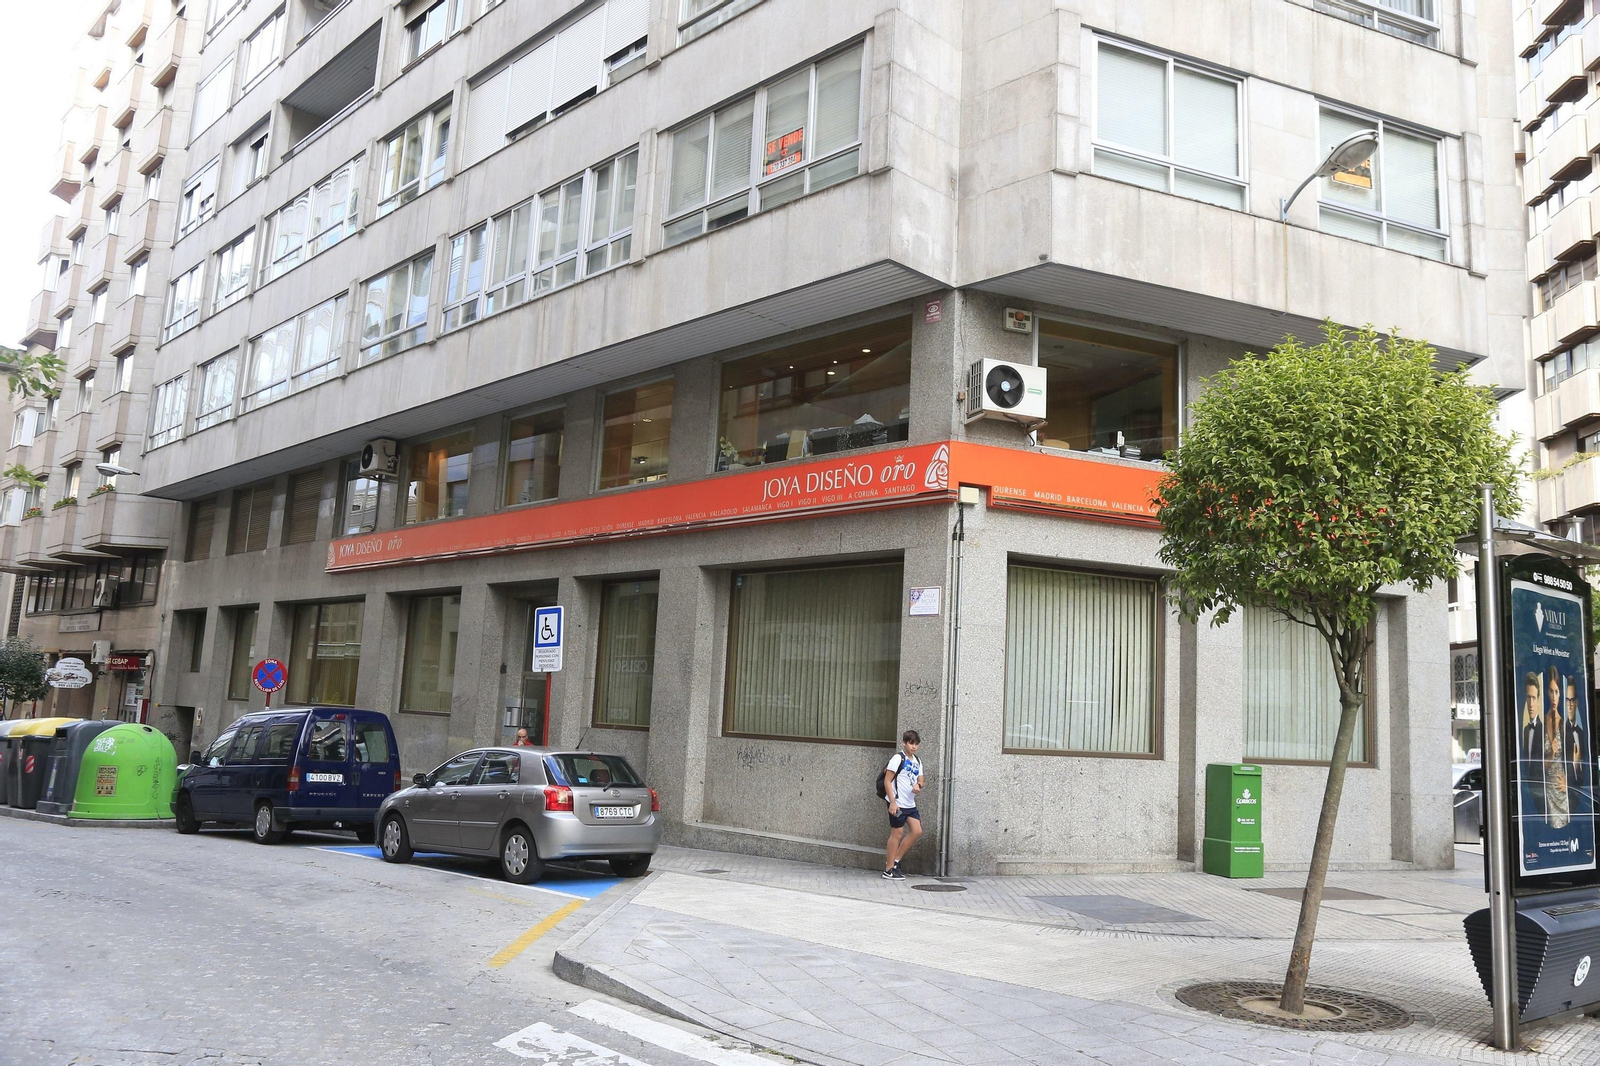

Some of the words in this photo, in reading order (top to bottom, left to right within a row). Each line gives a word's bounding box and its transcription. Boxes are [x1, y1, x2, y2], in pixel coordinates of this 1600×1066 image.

[767, 140, 777, 155] SE
[778, 129, 804, 150] VENDE
[762, 478, 801, 502] JOYA
[806, 463, 874, 493] DISEÑO
[880, 461, 916, 483] oro
[616, 521, 634, 529] OURENSE
[638, 518, 654, 526] MADRID
[657, 515, 682, 525] BARCELONA
[685, 511, 707, 520] VALENCIA
[710, 507, 738, 517] VALLADOLID
[742, 503, 772, 514] SALAMANCA
[776, 500, 790, 508] VIGO
[798, 497, 811, 506] VIGO
[822, 494, 836, 503] VIGO
[854, 488, 879, 499] CORUÑA
[884, 484, 915, 495] SANTIAGO
[993, 485, 1027, 497] OURENSE
[1033, 491, 1062, 501] MADRID
[1066, 495, 1107, 508] BARCELONA
[1111, 501, 1144, 513] VALENCIA
[339, 543, 355, 559] JOYA
[356, 538, 383, 555] DISEÑO
[1543, 574, 1554, 585] 988
[1553, 576, 1560, 588] 54
[1559, 578, 1567, 590] 50
[1566, 580, 1573, 591] 50
[600, 807, 618, 816] 8769
[619, 807, 633, 816] CTC
